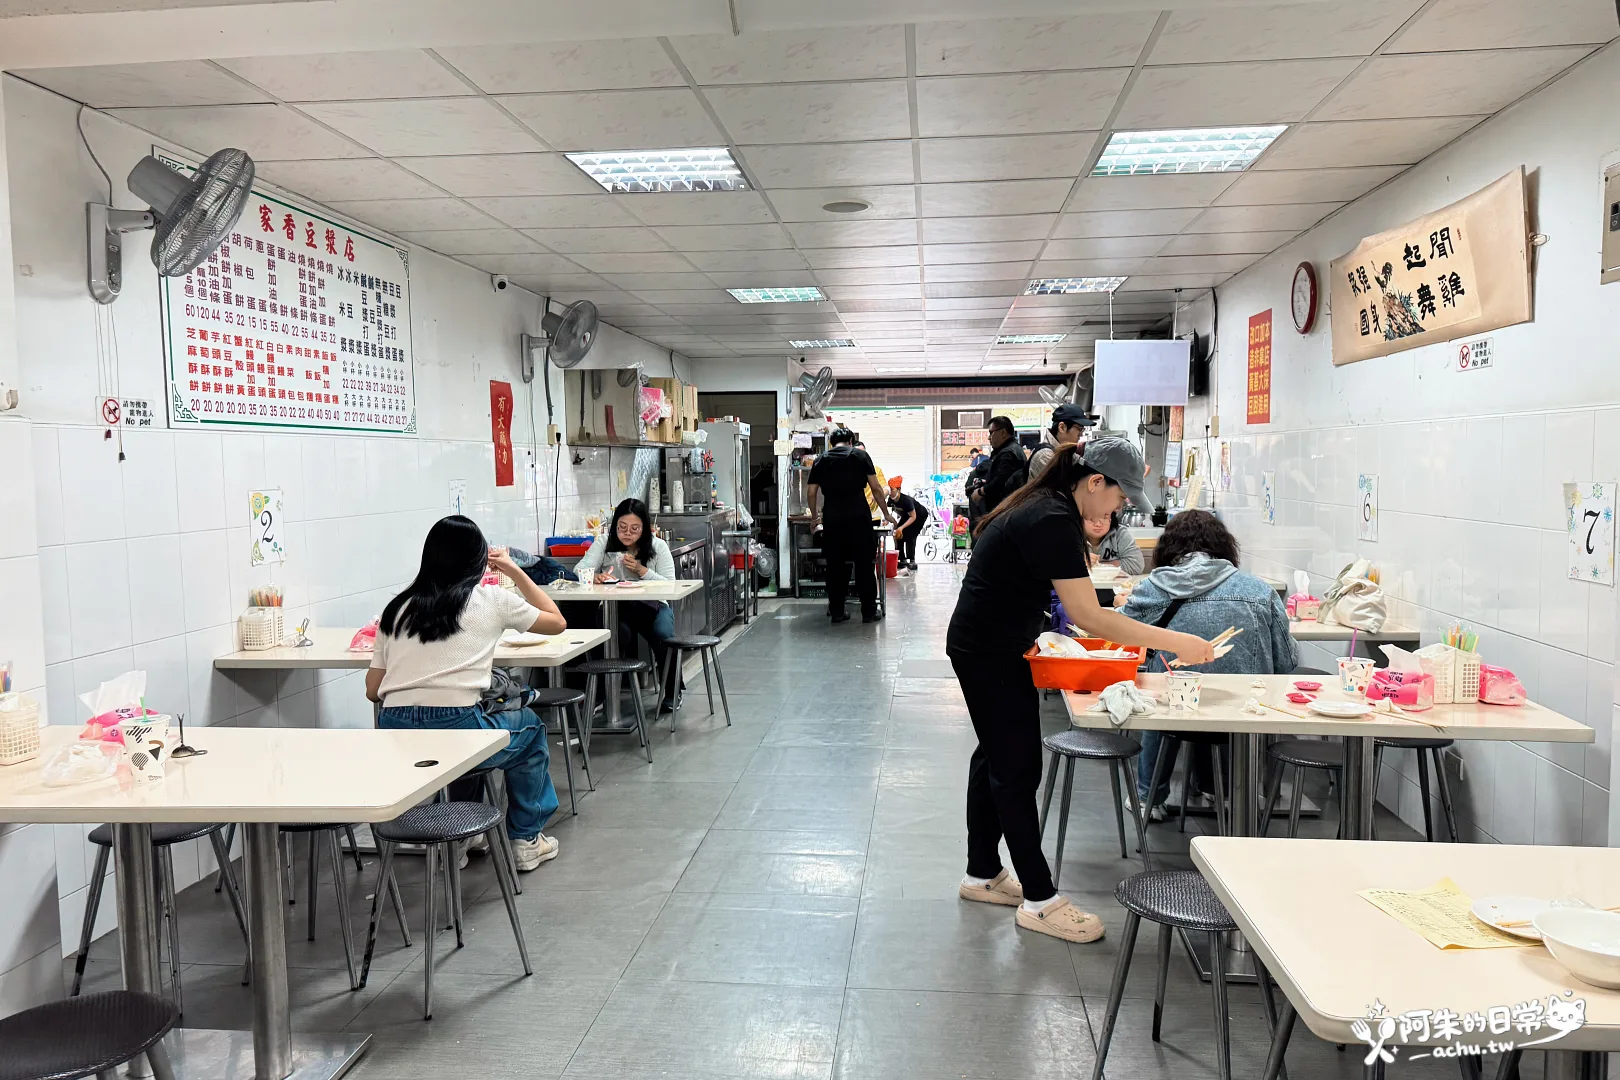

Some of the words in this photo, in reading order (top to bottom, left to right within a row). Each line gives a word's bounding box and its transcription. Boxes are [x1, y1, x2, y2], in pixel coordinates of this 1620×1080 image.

[259, 203, 355, 262] 家香豆漿店
[186, 304, 195, 317] 60
[197, 306, 209, 320] 120
[212, 309, 220, 321] 44
[225, 311, 233, 324] 35
[236, 314, 245, 326] 22
[248, 317, 256, 328] 15
[260, 318, 268, 330] 15
[270, 321, 278, 333] 55
[281, 323, 289, 335] 40
[291, 325, 299, 337] 22
[301, 327, 309, 339] 55
[311, 329, 318, 340] 44
[320, 331, 327, 342] 35
[329, 333, 336, 344] 22
[186, 327, 199, 391] 芝麻酥餅
[211, 331, 223, 394] 芋頭酥餅
[222, 333, 234, 395] 紅豆酥餅
[1472, 359, 1478, 367] No
[1481, 357, 1489, 366] pet
[342, 378, 349, 388] 22
[350, 379, 356, 389] 22
[357, 380, 363, 390] 22
[126, 417, 135, 425] No
[139, 418, 151, 426] pet
[190, 398, 200, 411] 20
[203, 399, 212, 412] 20
[215, 401, 224, 413] 20
[227, 402, 235, 414] 20
[238, 402, 246, 415] 20
[248, 403, 257, 415] 35
[259, 405, 267, 416] 20
[269, 405, 277, 417] 35
[280, 406, 287, 417] 20
[289, 407, 296, 418] 22
[299, 408, 305, 419] 22
[307, 408, 315, 419] 40
[316, 409, 323, 419] 40
[325, 409, 332, 420] 50
[333, 410, 340, 420] 40
[344, 411, 350, 422] 27
[1362, 493, 1371, 522] 6
[260, 510, 274, 543] 2
[1583, 508, 1601, 554] 7
